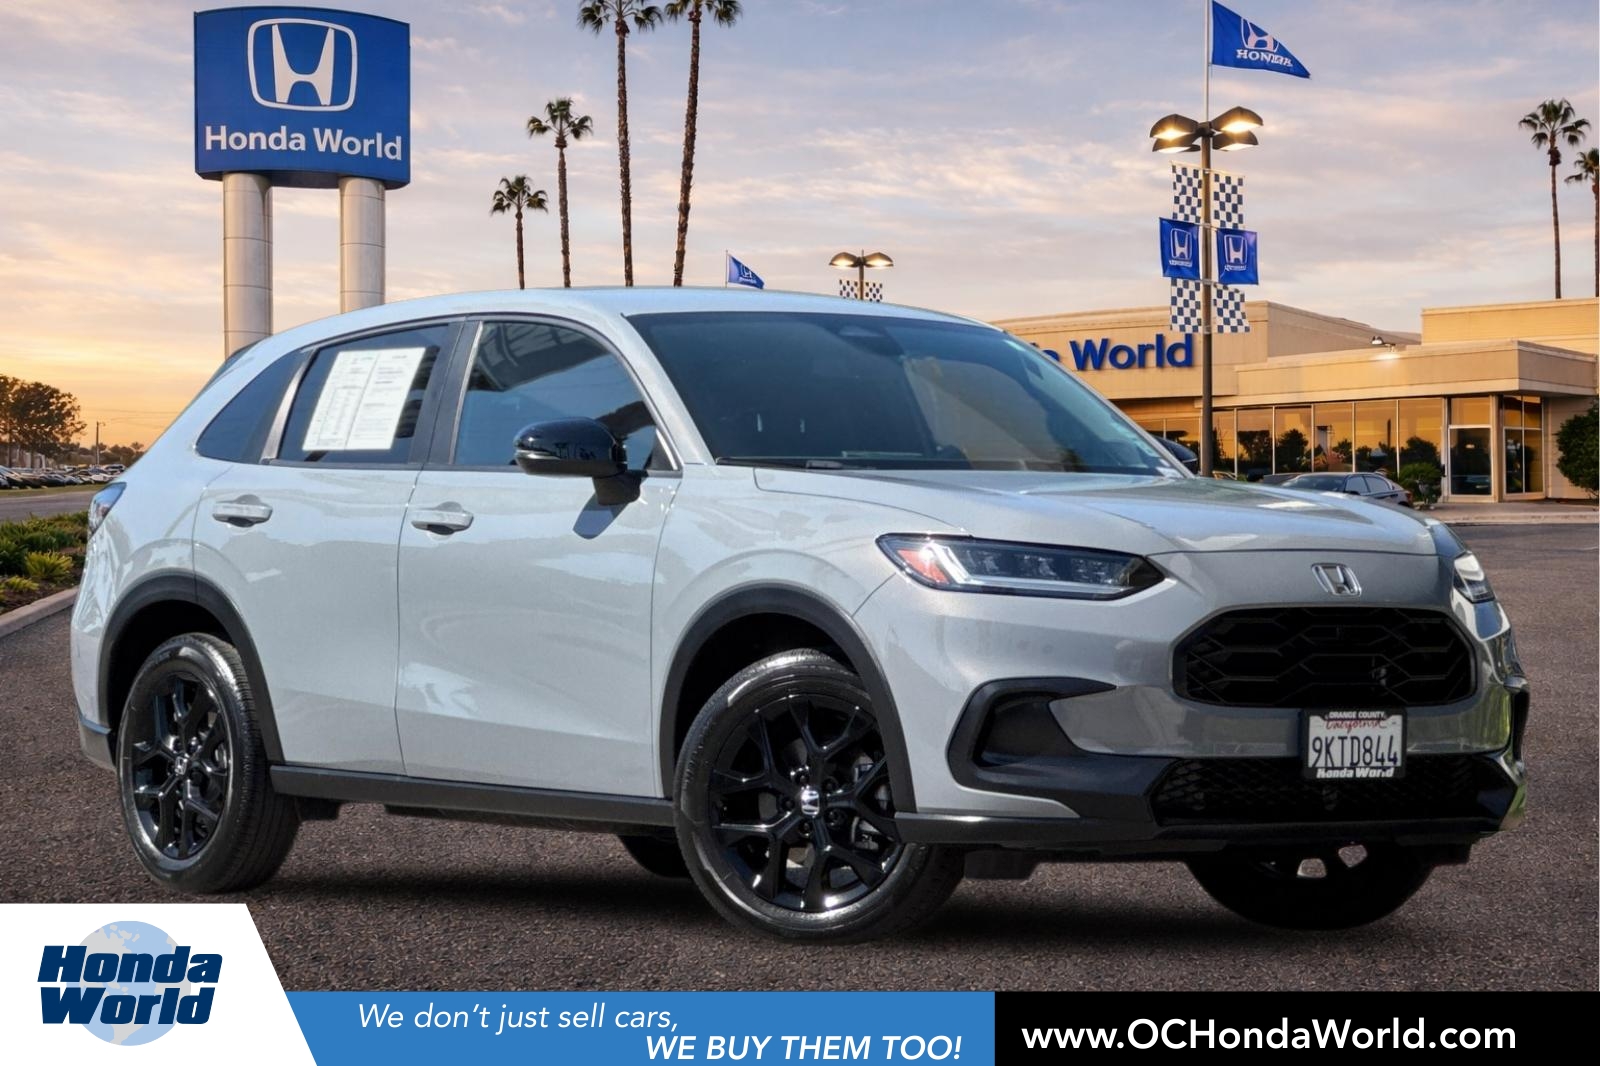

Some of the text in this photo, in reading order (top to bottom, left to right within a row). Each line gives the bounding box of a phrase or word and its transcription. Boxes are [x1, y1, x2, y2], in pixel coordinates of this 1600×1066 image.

[205, 125, 402, 161] Honda World
[1069, 333, 1194, 370] World
[1328, 711, 1385, 719] ORANGE COUNTY
[1311, 735, 1398, 768] 9KTD844
[1316, 767, 1355, 778] Honda
